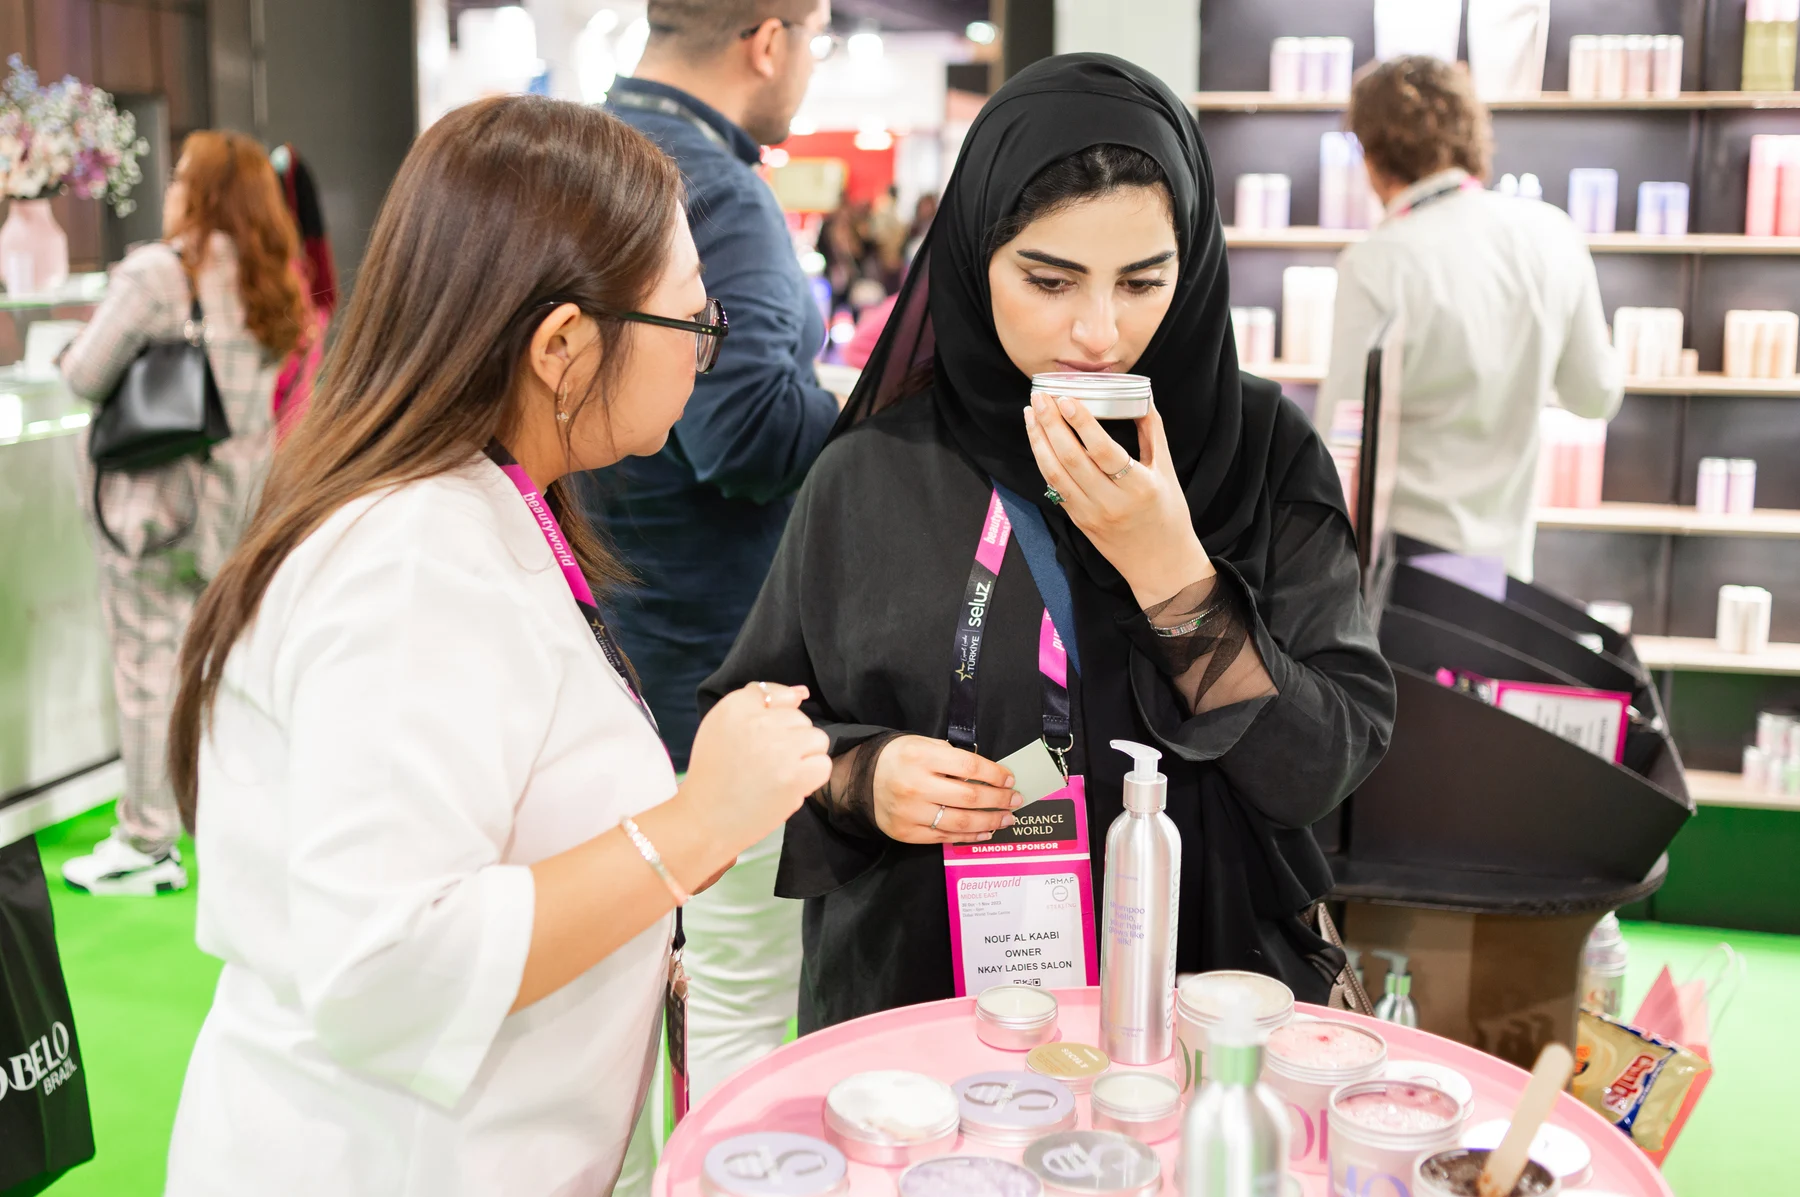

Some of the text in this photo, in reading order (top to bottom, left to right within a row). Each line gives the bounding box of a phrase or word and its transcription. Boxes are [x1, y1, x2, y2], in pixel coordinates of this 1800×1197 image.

[523, 491, 575, 567] beautyworld
[1012, 825, 1054, 836] WORLD
[972, 842, 1059, 853] DIAMOND SPONSOR
[960, 876, 1022, 891] beautyworld
[983, 891, 998, 899] EAST
[1109, 901, 1145, 914] shampoo
[1126, 922, 1143, 931] hair
[984, 931, 1060, 944] NOUF AL KAABI
[1005, 947, 1042, 958] OWNER
[977, 960, 1072, 974] NKAY LADIES SALON
[42, 1056, 78, 1096] BRAZIL
